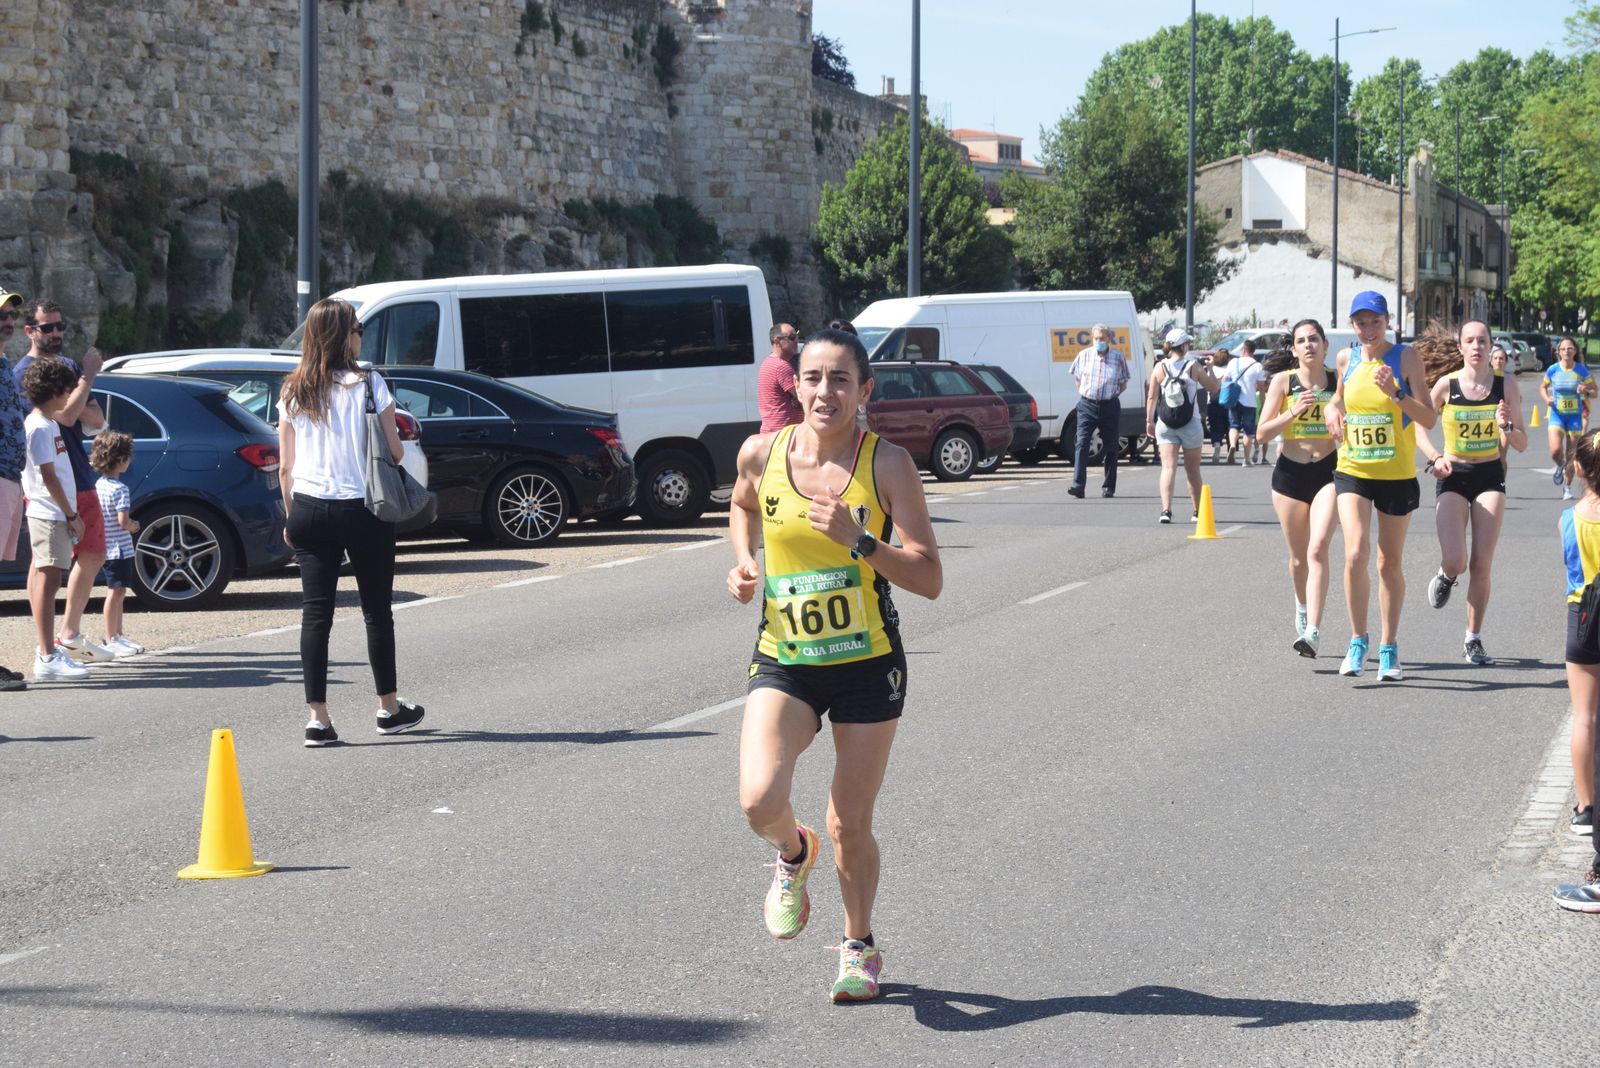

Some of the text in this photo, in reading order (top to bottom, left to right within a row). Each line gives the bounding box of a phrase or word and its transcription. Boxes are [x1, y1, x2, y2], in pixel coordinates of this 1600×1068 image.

[1298, 404, 1323, 421] 24
[1353, 427, 1387, 446] 156
[1459, 422, 1494, 439] 244
[780, 595, 851, 636] 160
[802, 640, 866, 657] CAJA RURAL
